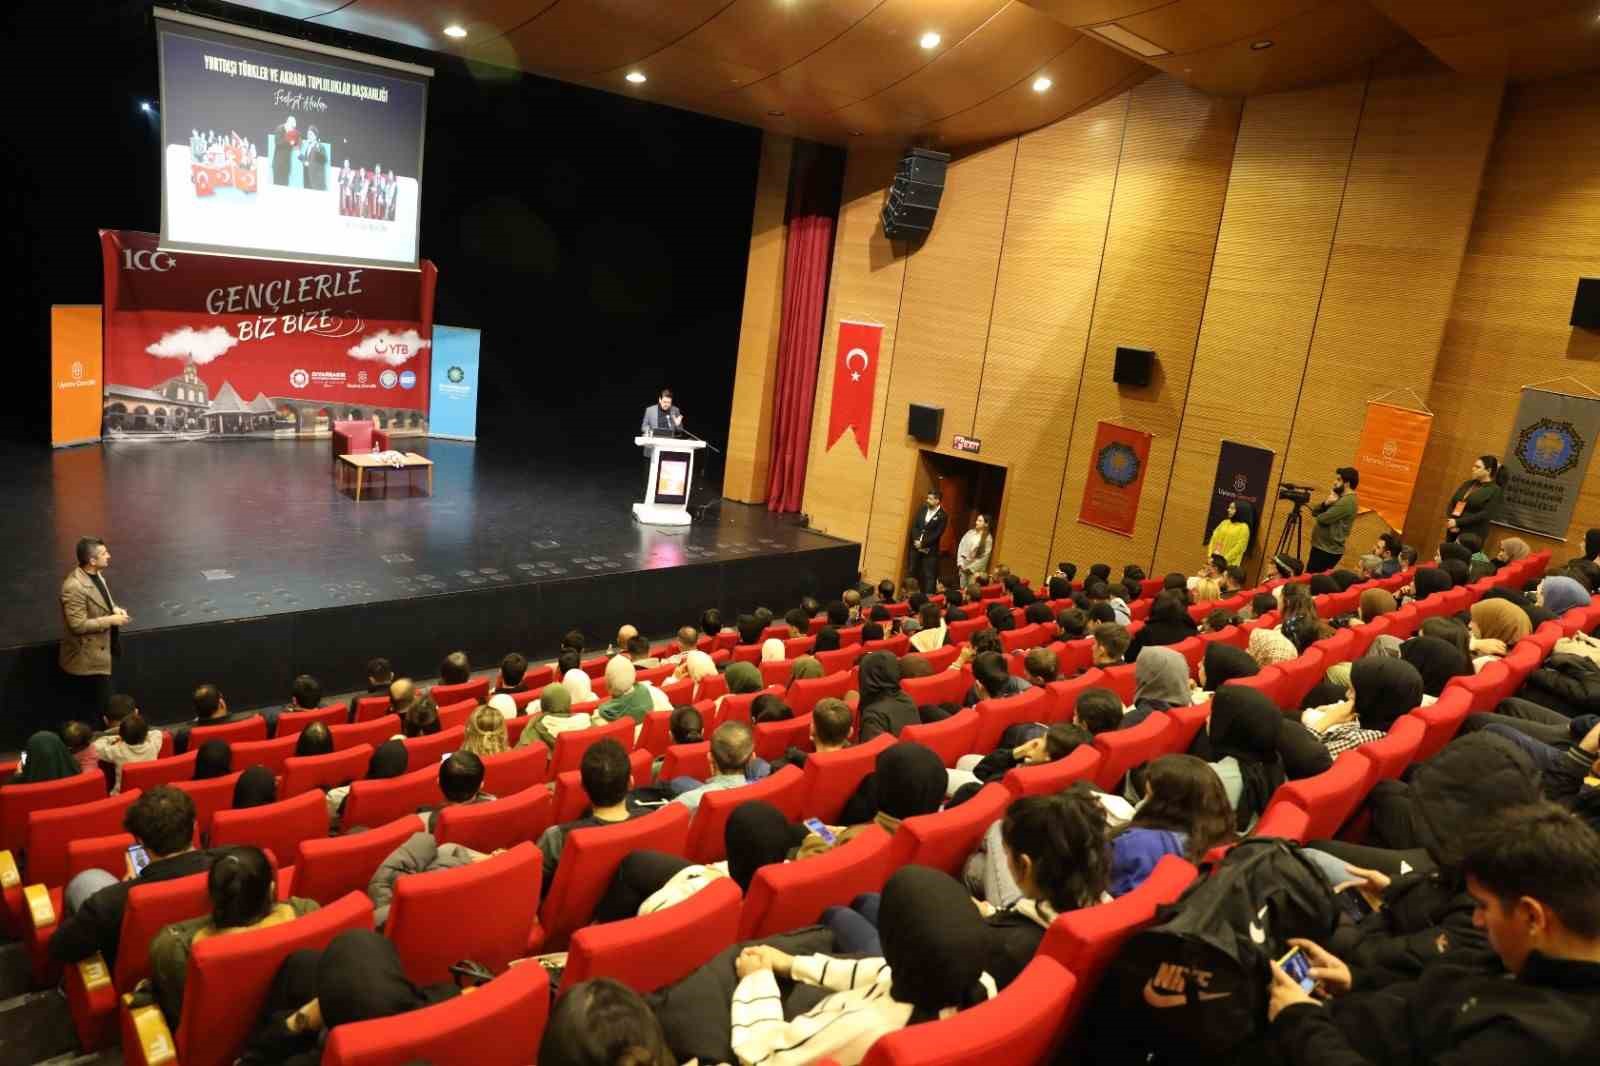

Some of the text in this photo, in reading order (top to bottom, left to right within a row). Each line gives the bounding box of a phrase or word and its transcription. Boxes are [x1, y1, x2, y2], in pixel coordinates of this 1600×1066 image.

[270, 68, 279, 82] VE
[206, 269, 363, 314] GENÇLERLE
[237, 309, 332, 341] BİZ BİZE
[389, 344, 409, 355] YTB
